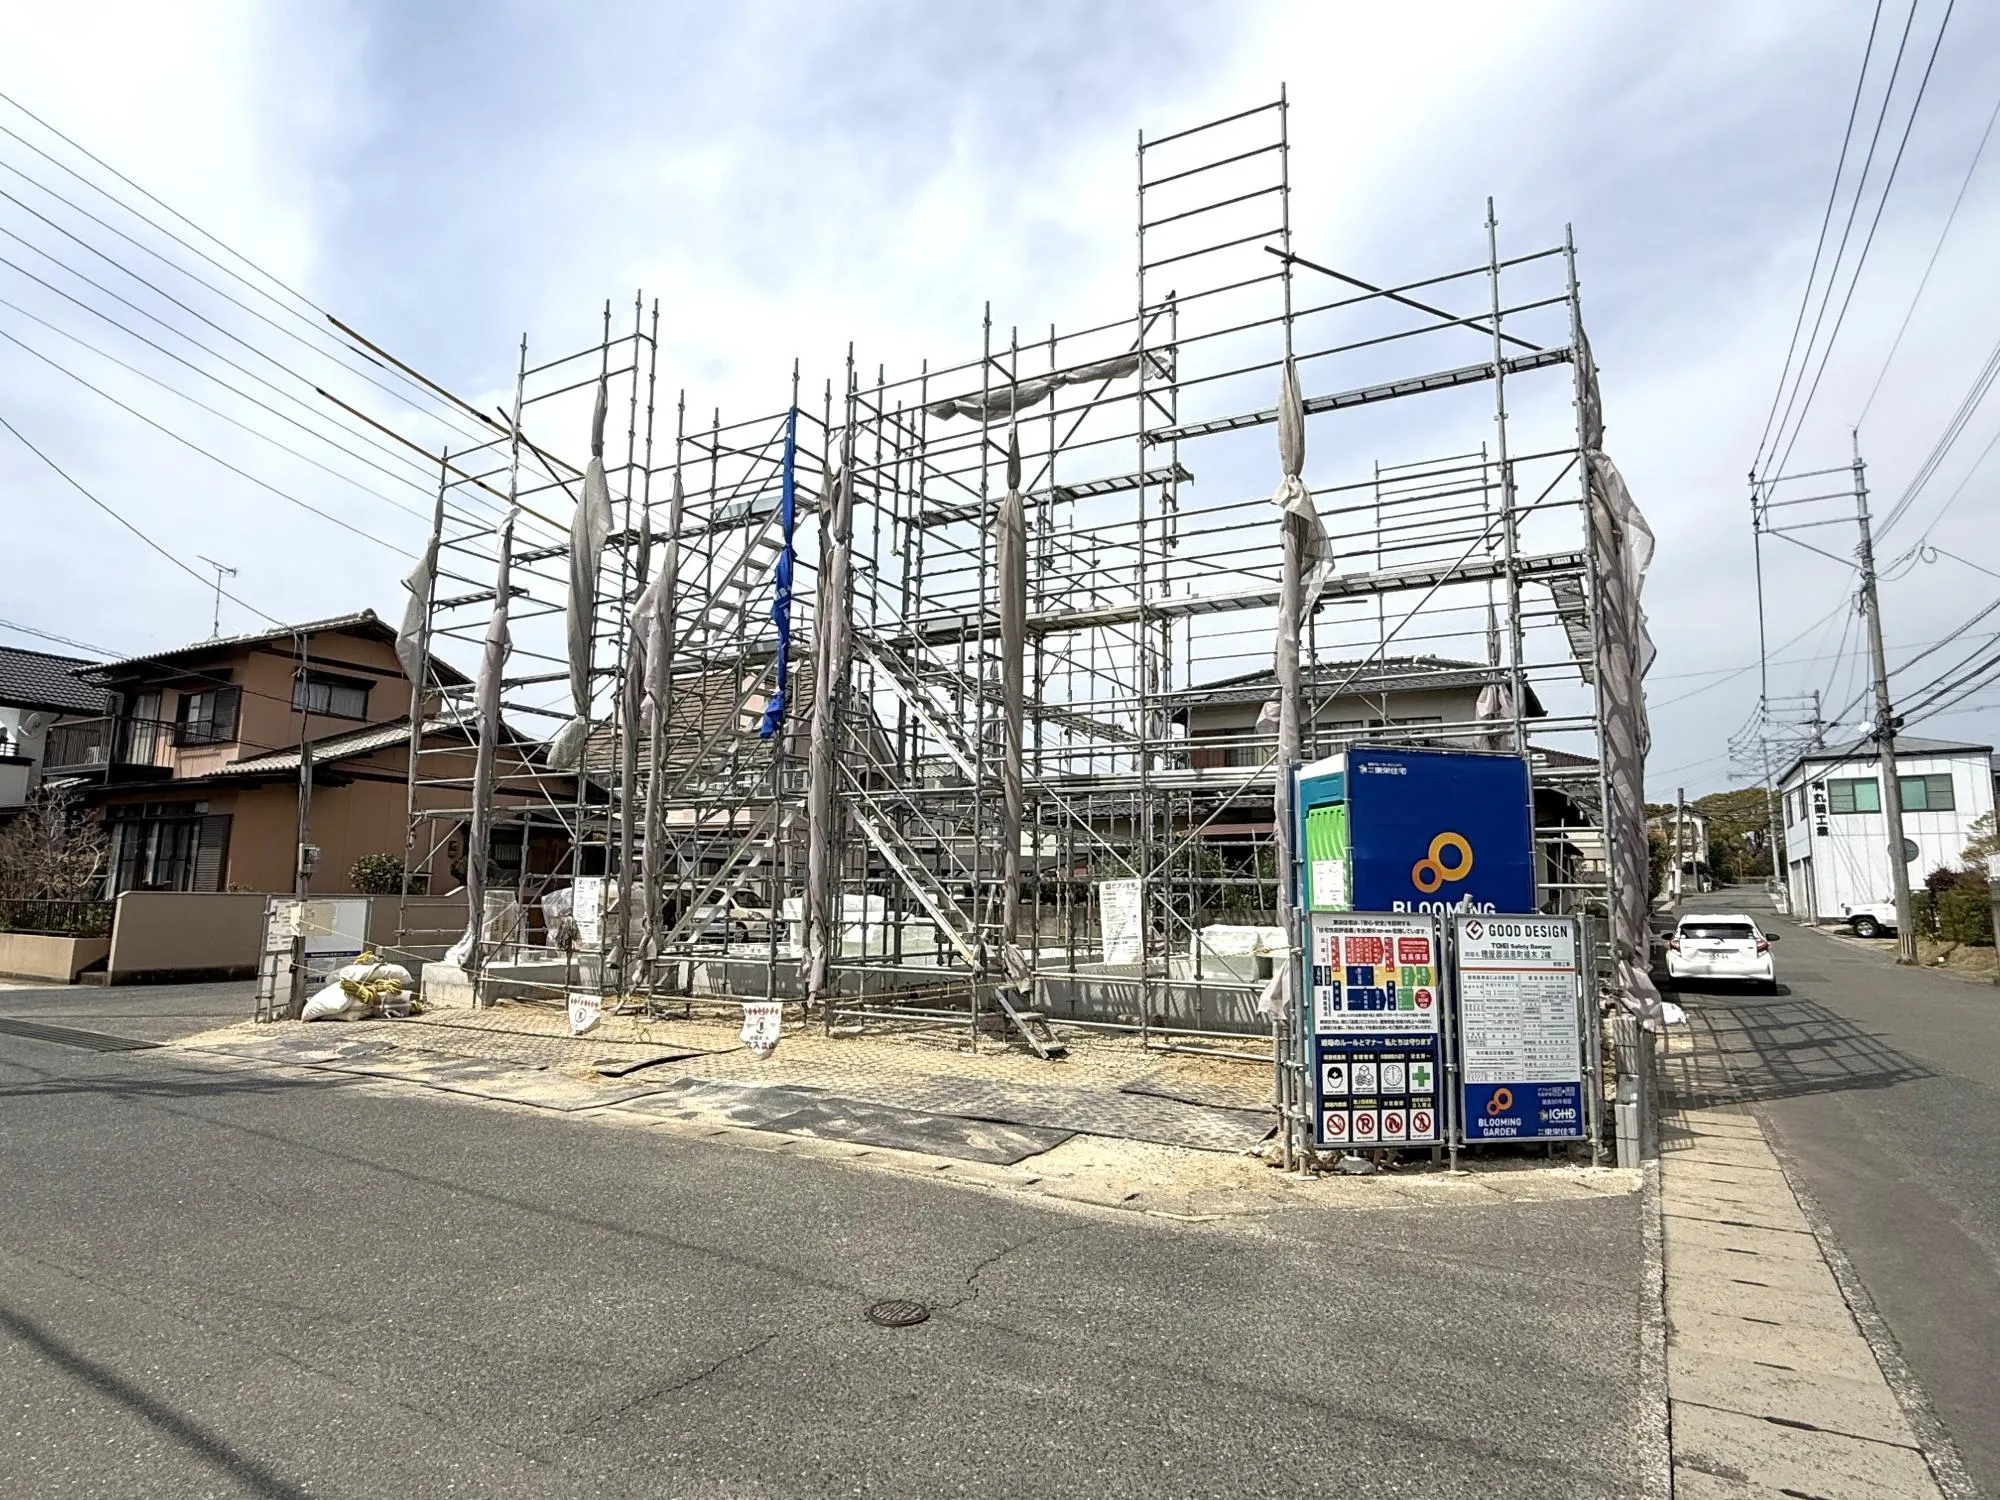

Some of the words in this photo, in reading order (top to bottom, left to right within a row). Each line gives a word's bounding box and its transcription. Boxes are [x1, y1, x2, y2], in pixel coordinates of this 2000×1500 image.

[1392, 900, 1496, 915] BLOOMNG
[1489, 924, 1521, 937] GOOD
[1525, 925, 1568, 938] DESIGN
[1478, 1117, 1522, 1127] BLOOMING
[1483, 1127, 1517, 1137] GARDEN
